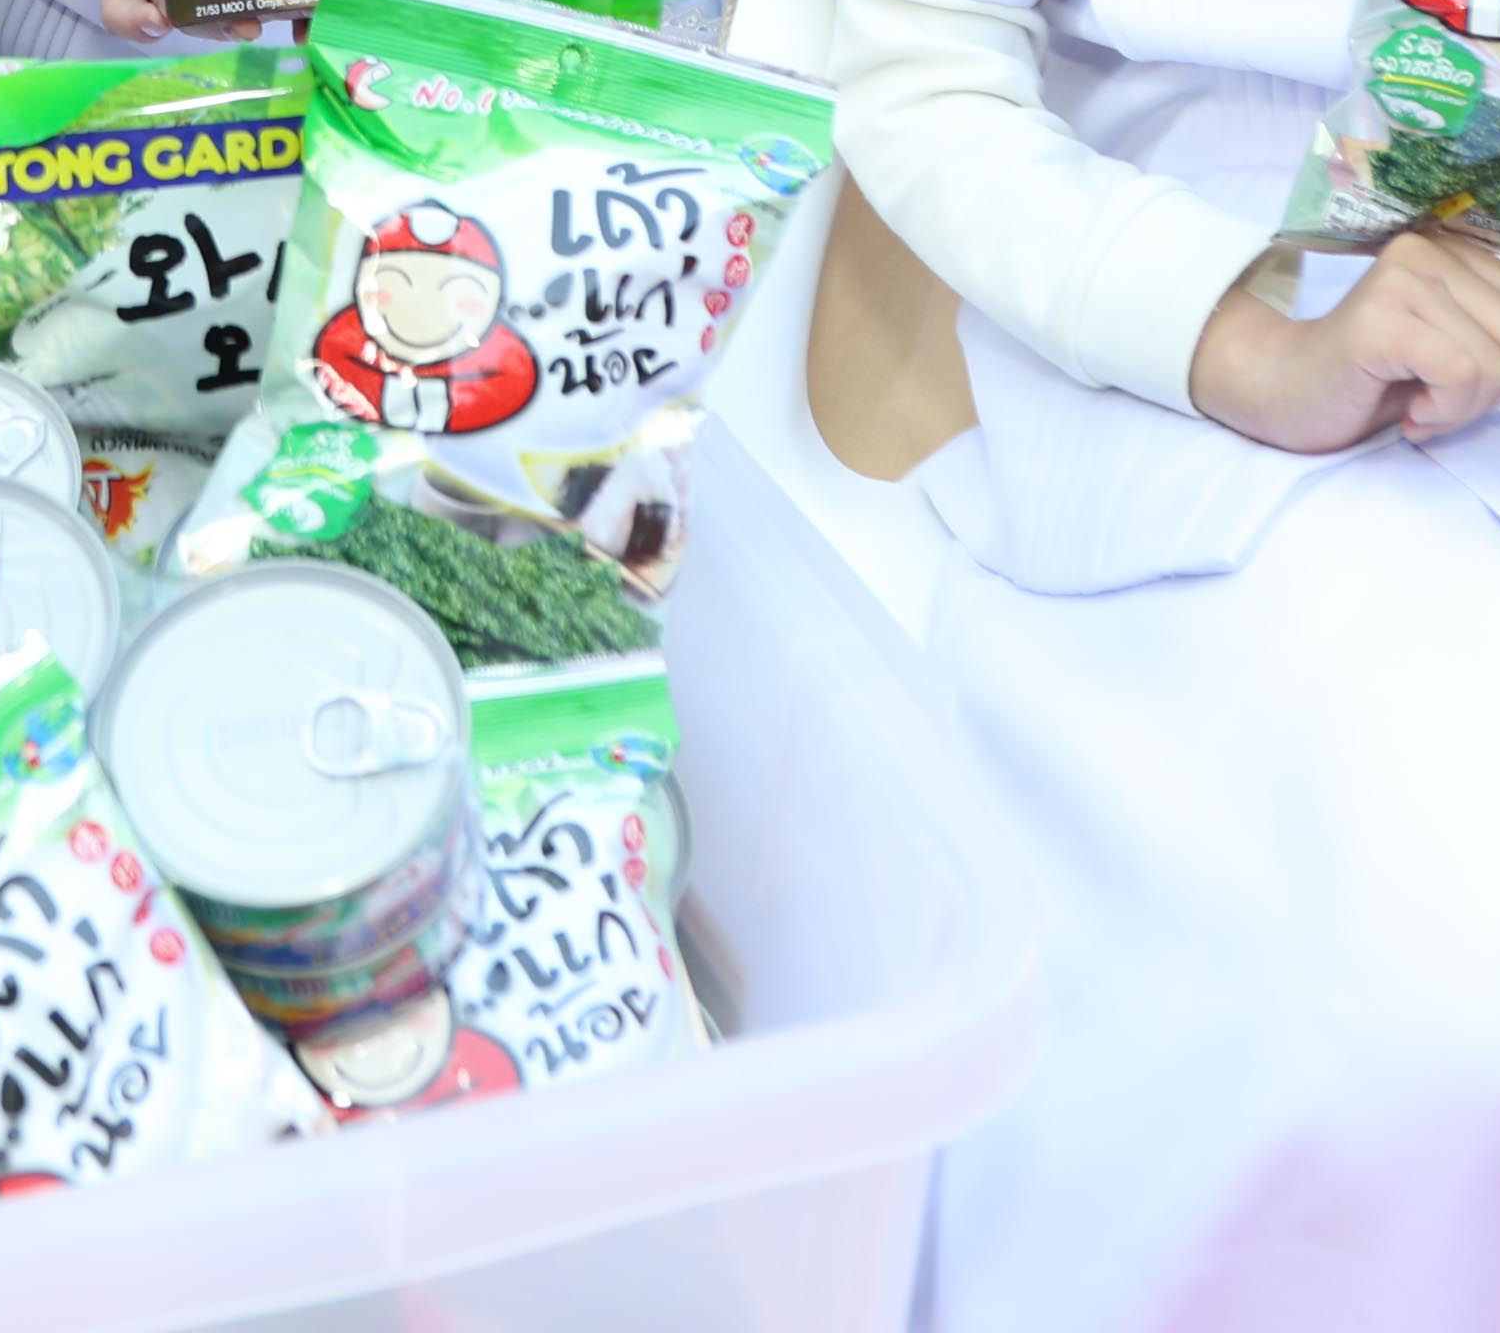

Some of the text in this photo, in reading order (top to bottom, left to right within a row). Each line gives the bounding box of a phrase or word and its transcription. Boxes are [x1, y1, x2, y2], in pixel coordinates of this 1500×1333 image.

[195, 4, 220, 17] 21/53
[221, 1, 245, 14] MOO
[140, 125, 305, 181] GARD
